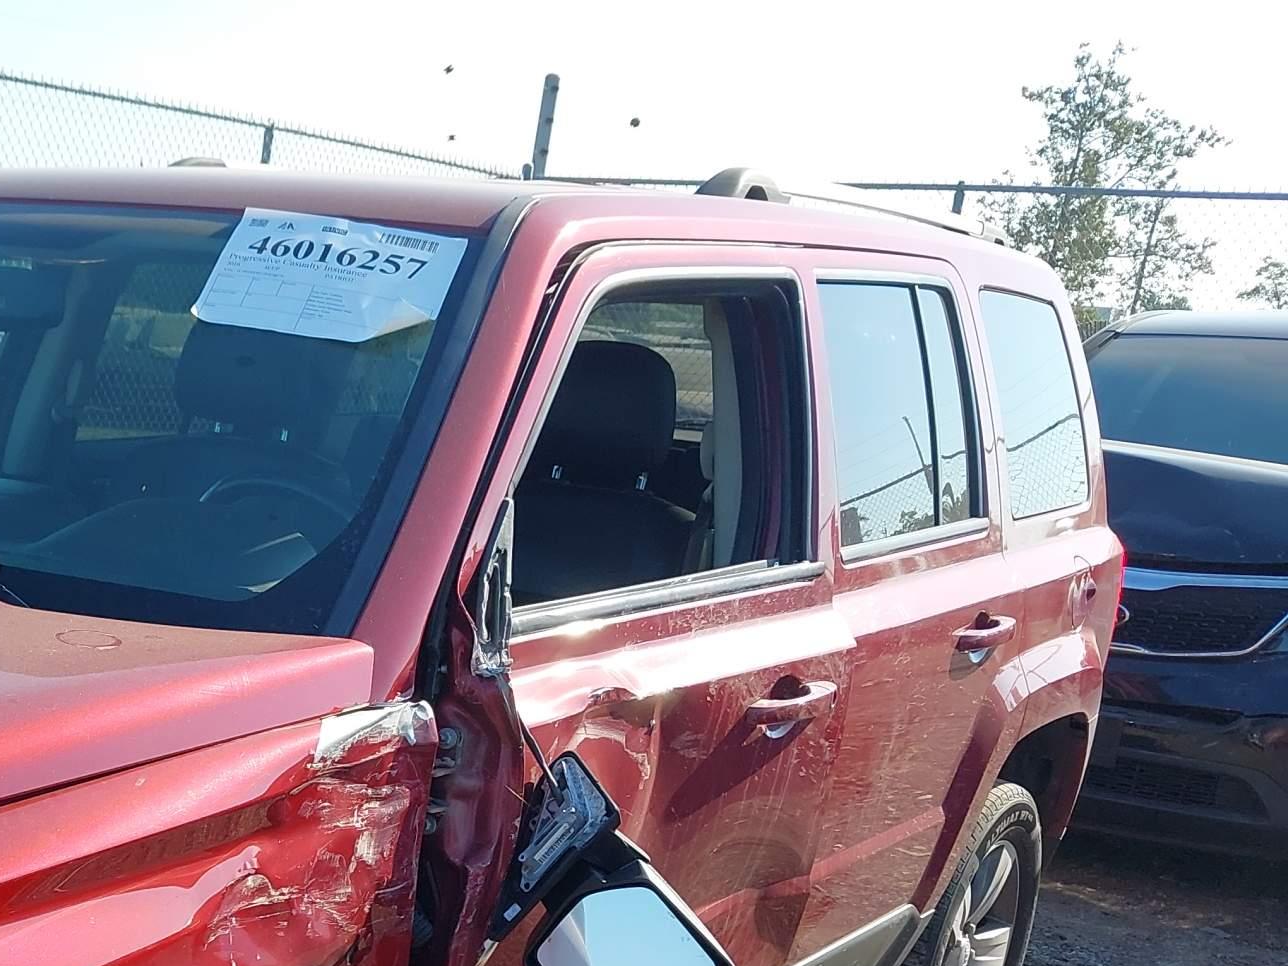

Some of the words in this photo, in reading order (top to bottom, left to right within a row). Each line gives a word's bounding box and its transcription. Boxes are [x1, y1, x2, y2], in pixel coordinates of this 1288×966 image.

[229, 253, 281, 265] Progressive
[282, 258, 321, 272] Casualty
[324, 264, 368, 278] Insurance
[248, 235, 429, 280] 46016257
